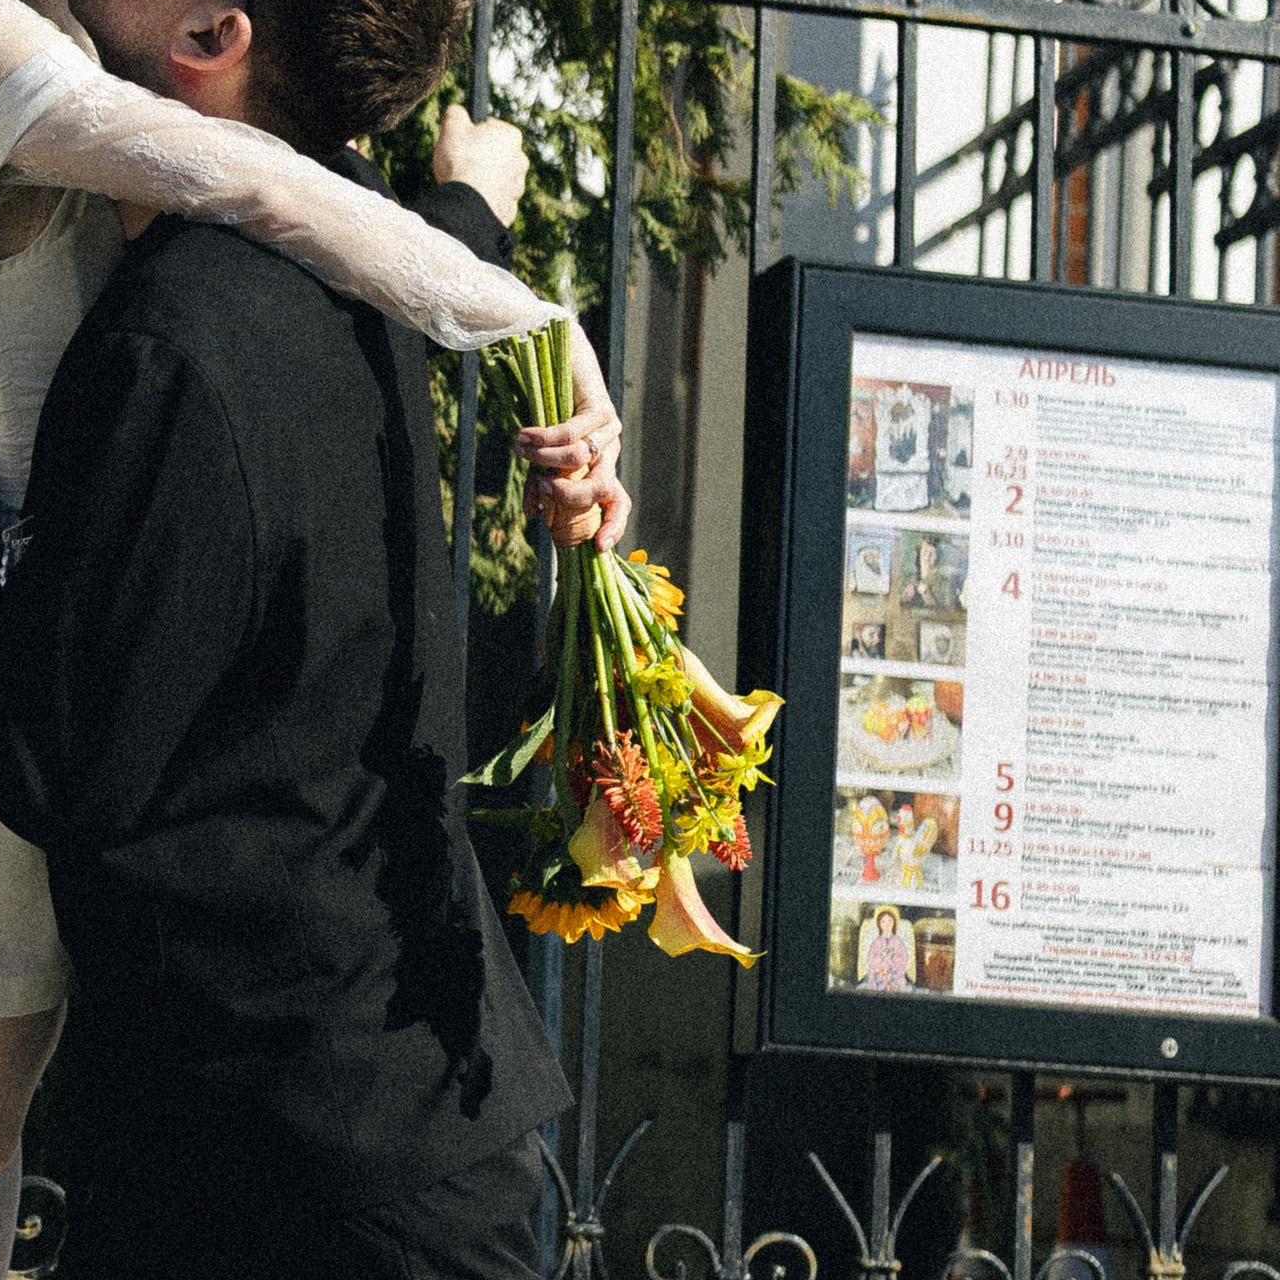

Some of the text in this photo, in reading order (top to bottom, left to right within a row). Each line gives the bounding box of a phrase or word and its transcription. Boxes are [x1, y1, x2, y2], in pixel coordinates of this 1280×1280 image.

[1019, 357, 1117, 387] АПРЕЛЬ
[1004, 484, 1025, 516] 2
[1001, 570, 1022, 601] 4
[995, 762, 1015, 793] 5
[993, 801, 1014, 833] 9
[967, 838, 1013, 858] 11,25
[969, 879, 1012, 912] 16
